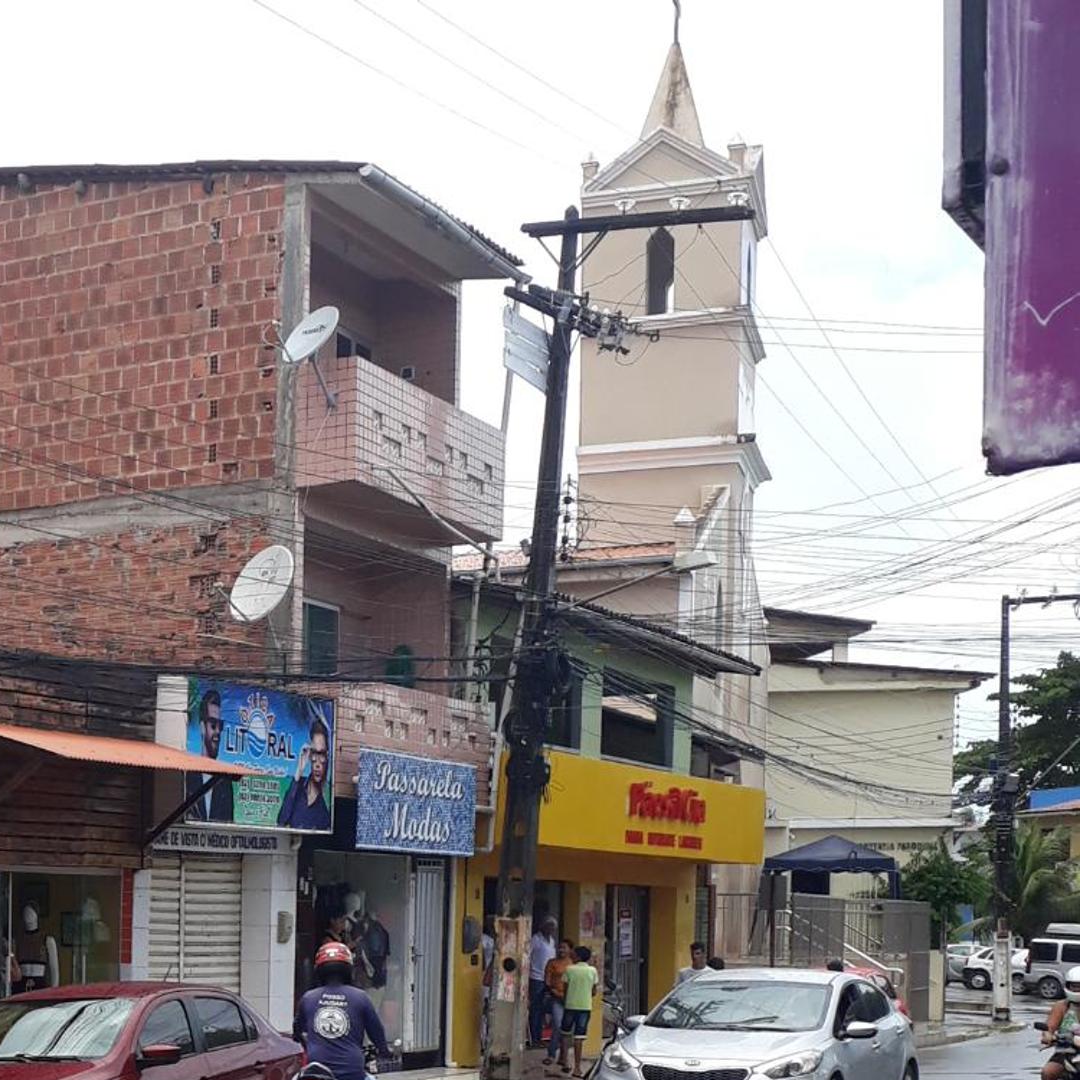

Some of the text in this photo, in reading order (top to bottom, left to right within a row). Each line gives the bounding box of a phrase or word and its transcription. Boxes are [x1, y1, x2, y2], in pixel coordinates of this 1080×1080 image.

[374, 760, 465, 800] Passarela
[170, 831, 179, 846] DE
[384, 802, 451, 842] Modas
